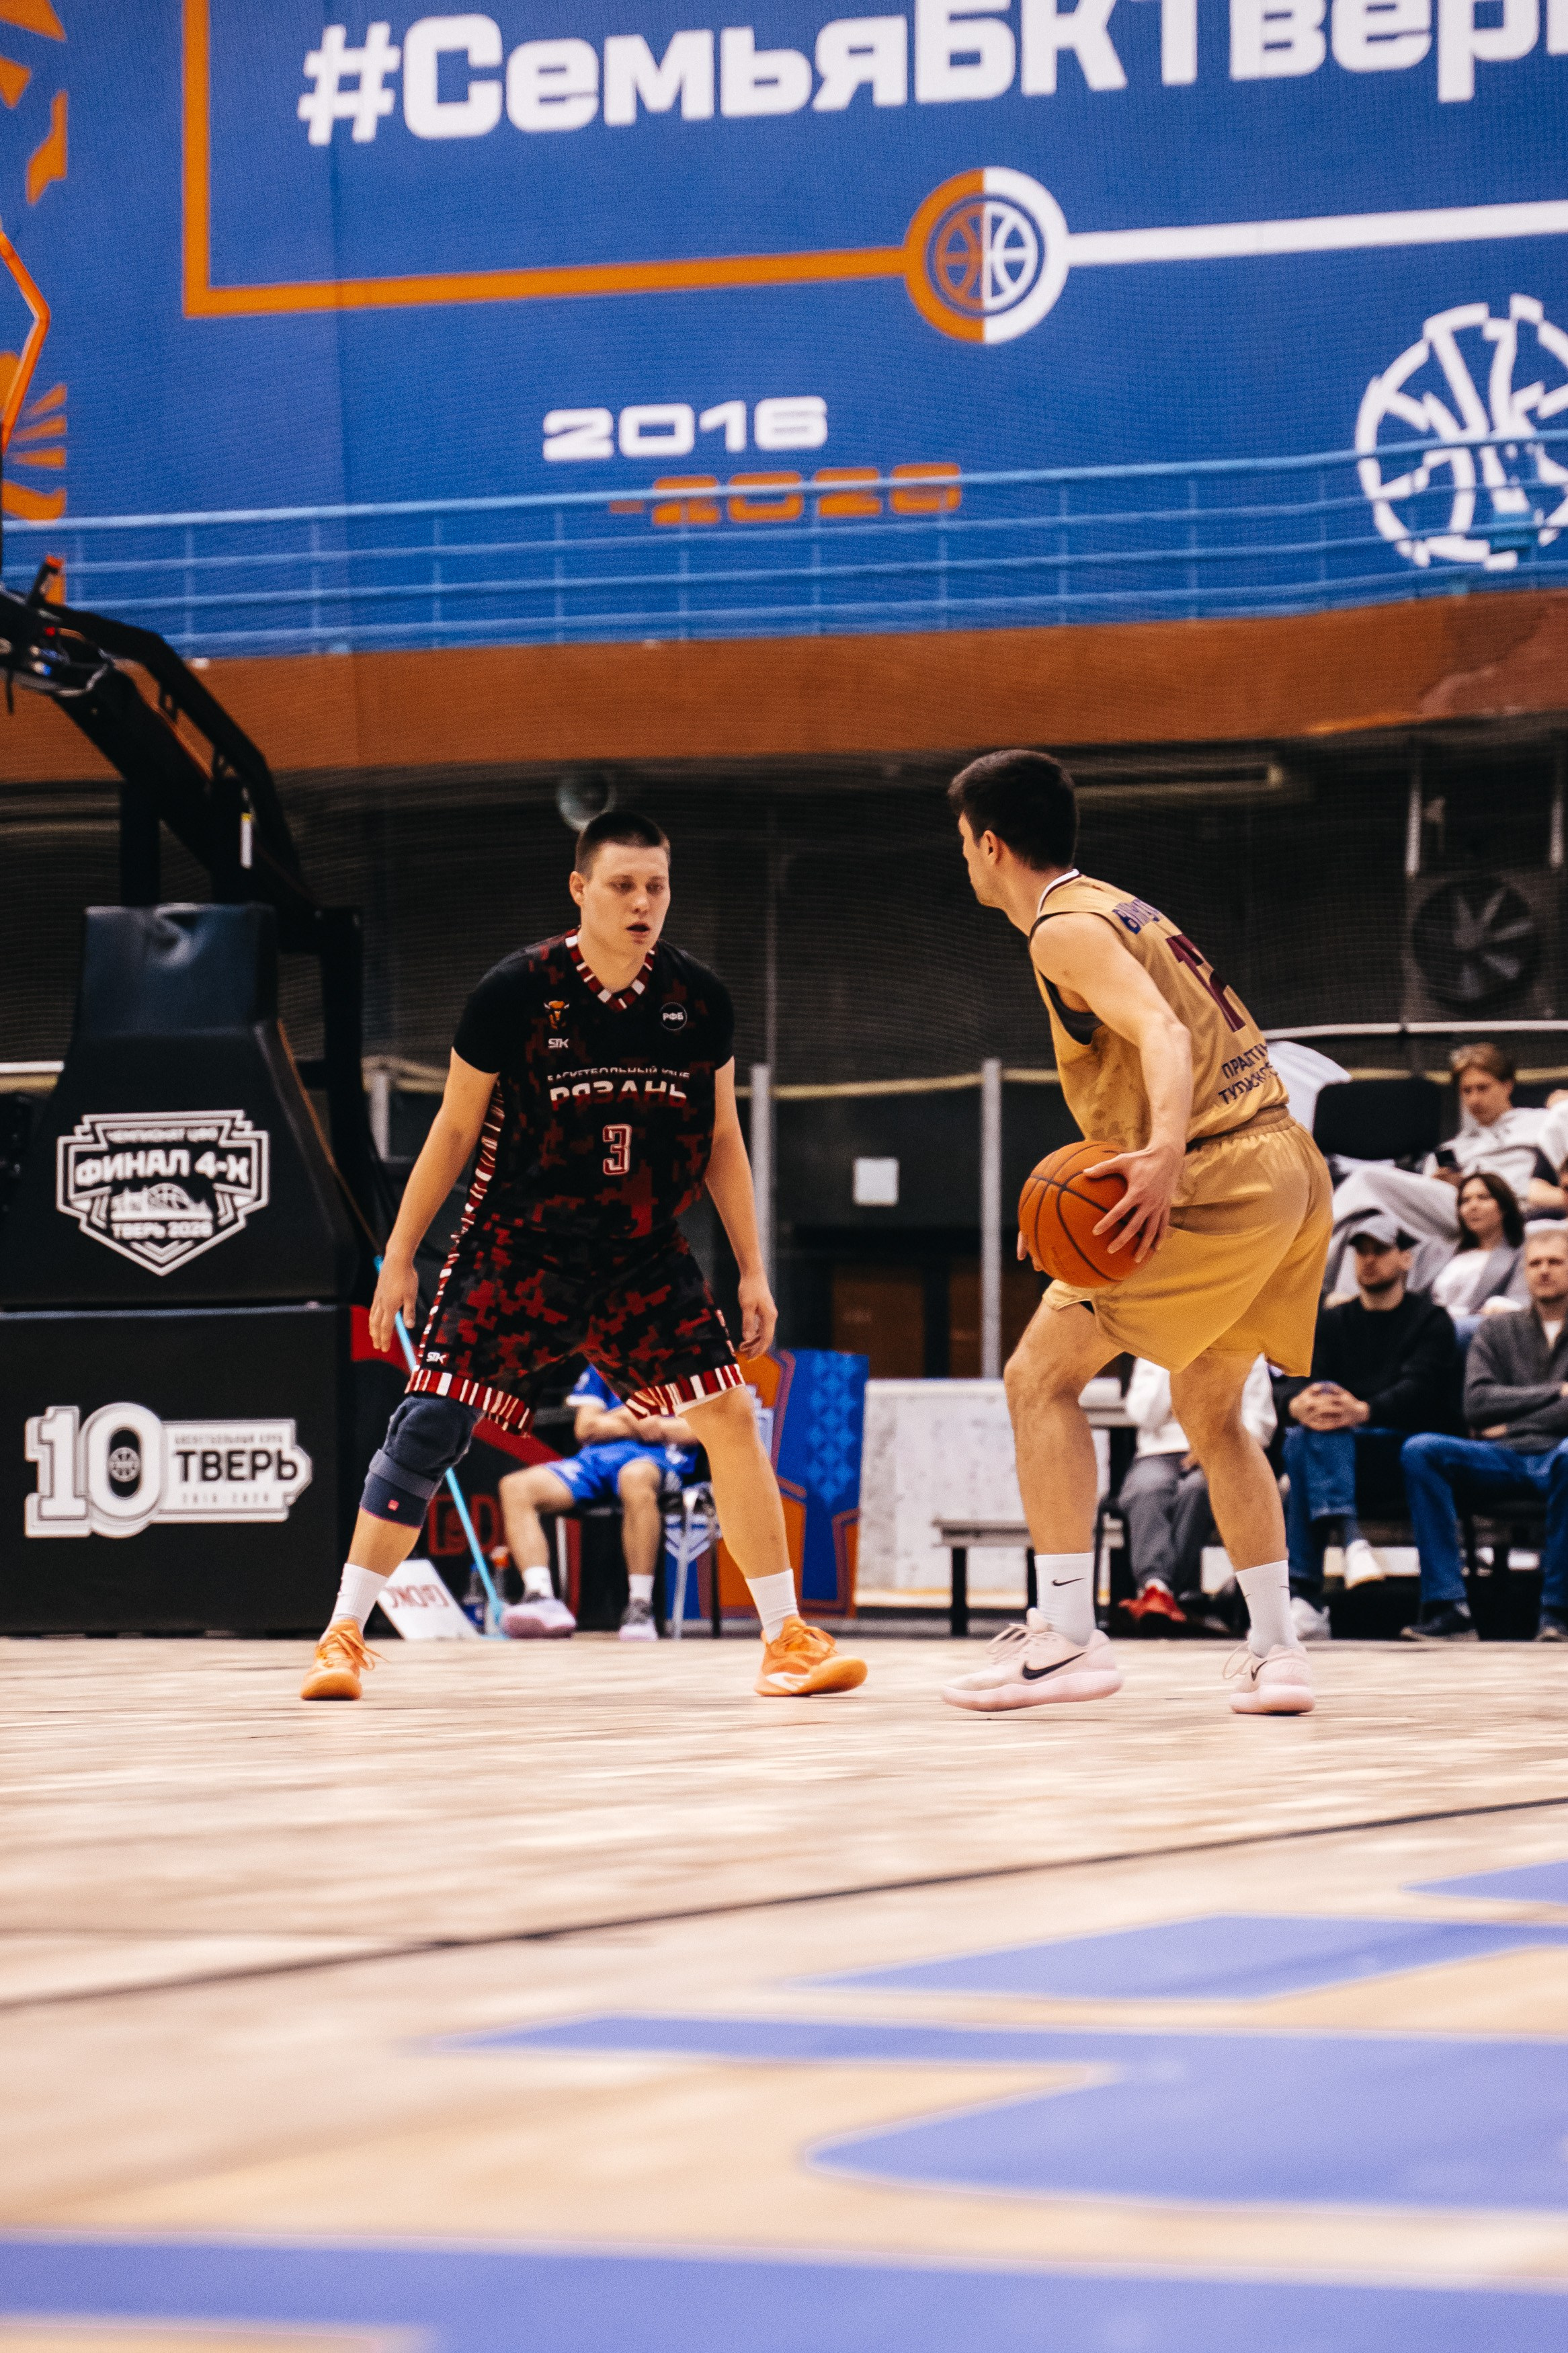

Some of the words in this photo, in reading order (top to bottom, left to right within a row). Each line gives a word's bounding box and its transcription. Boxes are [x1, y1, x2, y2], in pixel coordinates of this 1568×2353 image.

[298, 0, 1568, 146] #СемьяБКТвер
[542, 395, 828, 463] 2016
[550, 1080, 687, 1111] РЯЗАНЬ
[75, 1149, 190, 1187] ФИНАЛ
[603, 1123, 632, 1176] 3
[26, 1402, 163, 1538] 10
[175, 1449, 298, 1482] ТВЕРЬ
